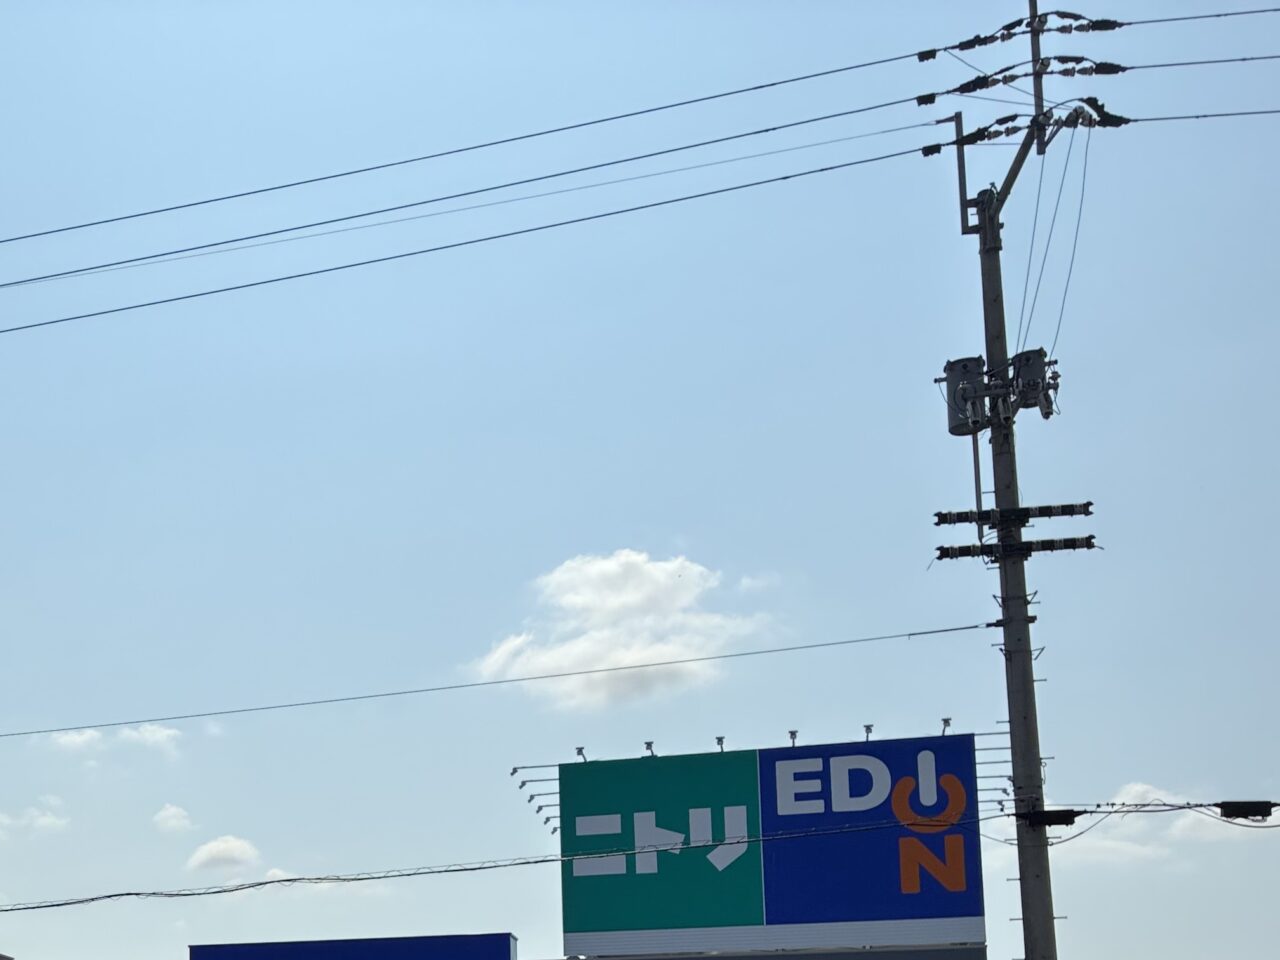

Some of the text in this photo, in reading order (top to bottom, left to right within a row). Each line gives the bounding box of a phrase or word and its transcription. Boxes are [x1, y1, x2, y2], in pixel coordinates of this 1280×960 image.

[573, 805, 748, 877] ニトリ
[775, 749, 967, 894] EDION
